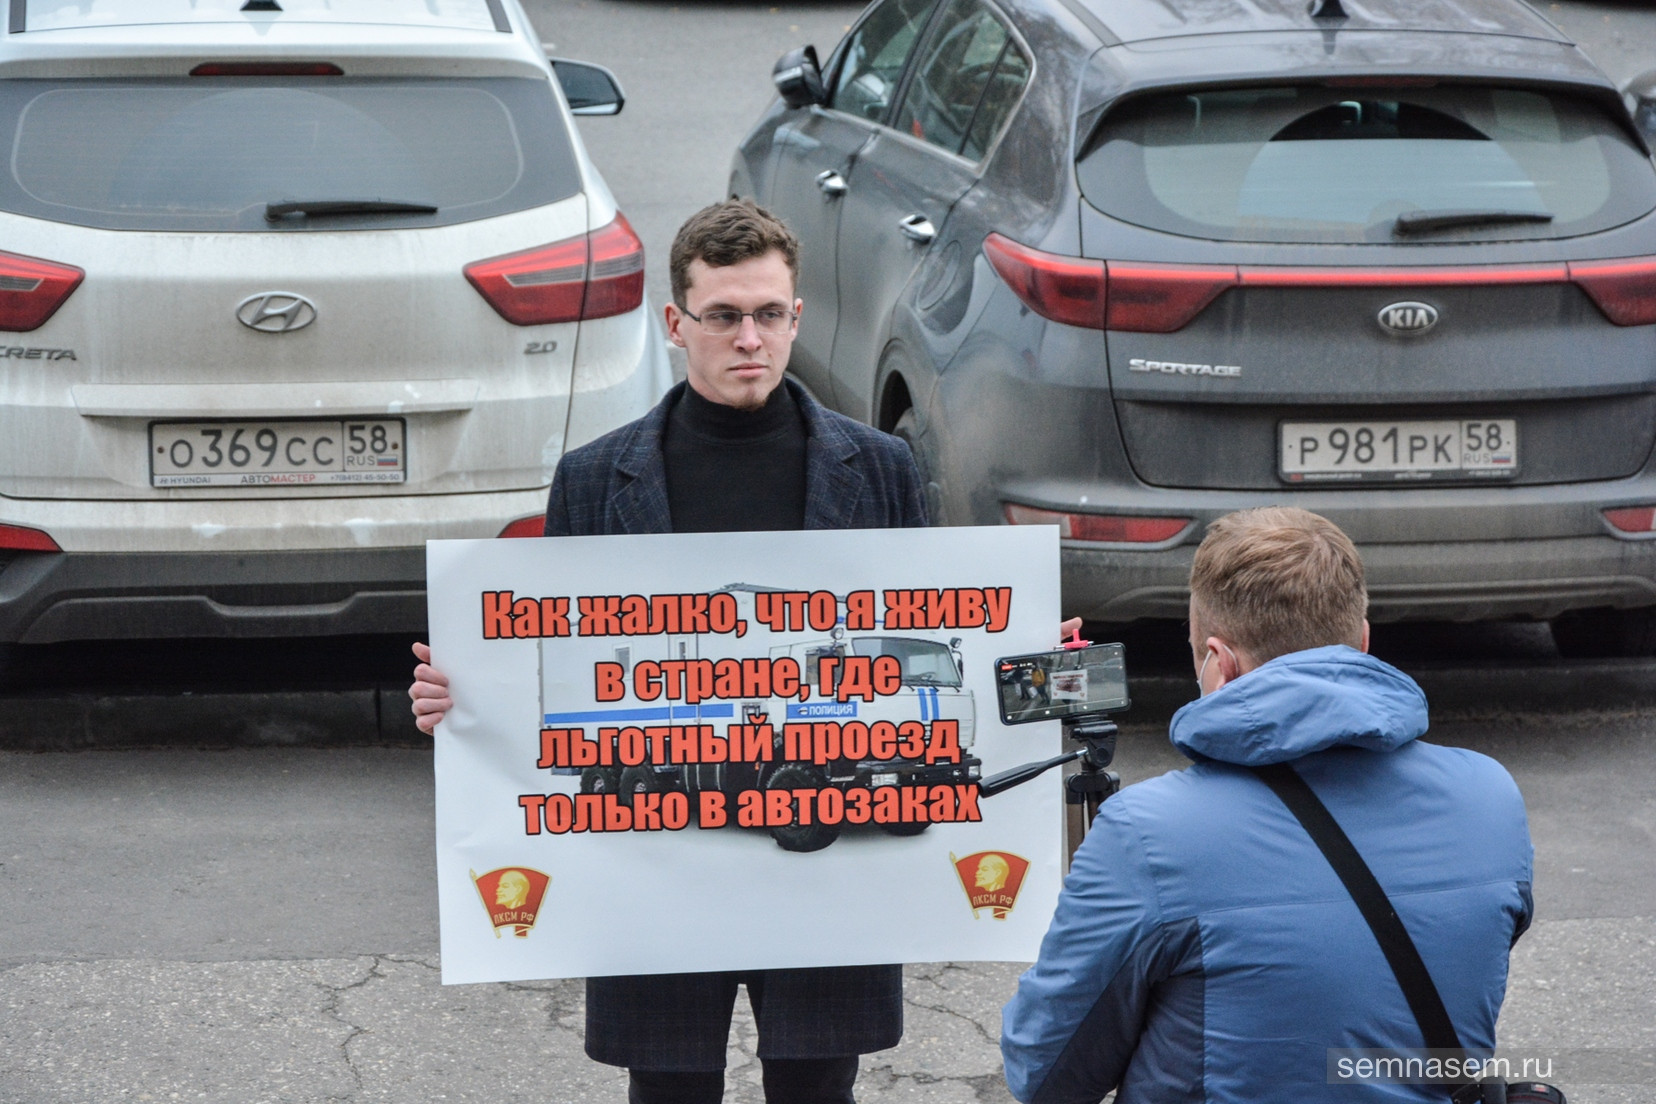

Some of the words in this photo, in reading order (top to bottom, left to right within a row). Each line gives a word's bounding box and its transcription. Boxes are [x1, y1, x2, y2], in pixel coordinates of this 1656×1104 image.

[1388, 308, 1429, 328] KIA
[1129, 358, 1242, 377] SPORTAGE
[346, 455, 376, 467] RUS
[1463, 452, 1491, 464] RUS
[170, 476, 211, 484] HYUNDAI
[240, 473, 316, 485] АВТОМАСТЕР
[482, 591, 571, 639] Как
[578, 592, 747, 638] жалко,
[755, 591, 837, 632] что
[846, 590, 876, 631] я
[883, 586, 1012, 632] живу
[595, 661, 625, 702] в
[634, 657, 810, 703] стране,
[818, 656, 901, 703] где
[809, 704, 853, 716] ПОЛИЦИЯ
[537, 713, 775, 768] льготный
[783, 719, 962, 765] проезд
[518, 790, 690, 835] только
[698, 789, 729, 831] в
[736, 783, 982, 829] автозаках
[1000, 894, 1013, 905] РФ
[521, 912, 534, 922] РФ
